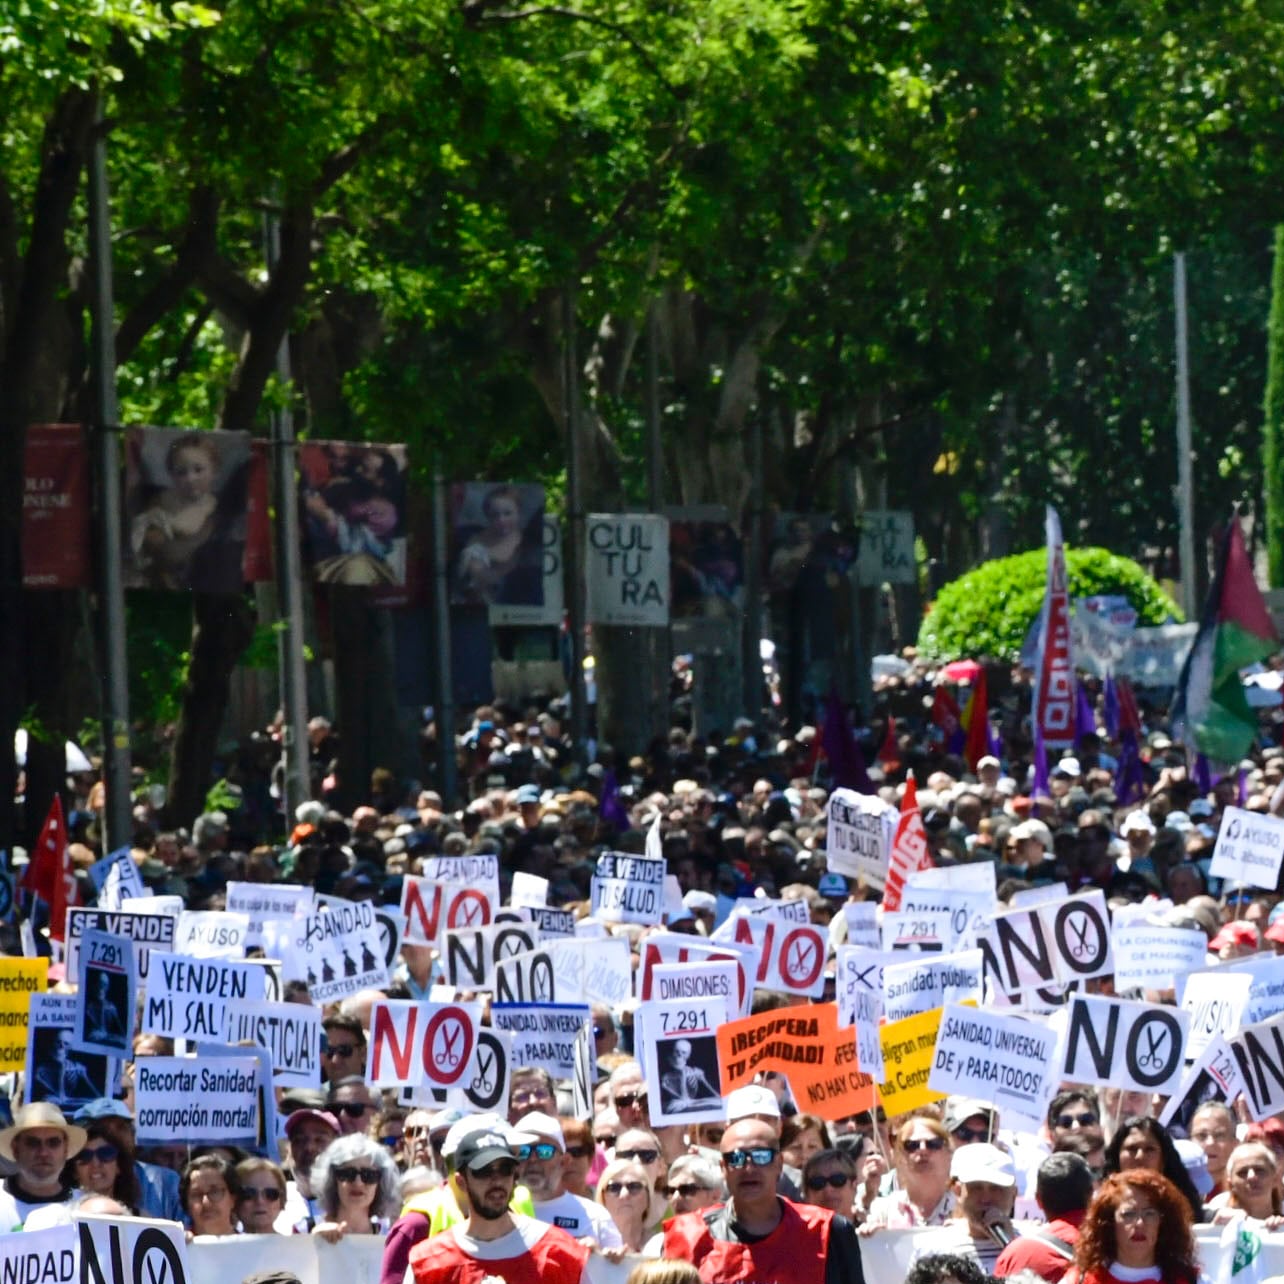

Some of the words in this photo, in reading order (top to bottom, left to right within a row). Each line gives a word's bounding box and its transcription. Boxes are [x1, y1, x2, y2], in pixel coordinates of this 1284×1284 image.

[588, 523, 653, 551] CUL
[600, 551, 643, 577] TU
[620, 579, 665, 607] RA
[835, 829, 849, 848] TU
[850, 832, 881, 860] SALUD
[615, 859, 663, 883] VENDE
[404, 880, 490, 942] NO
[613, 887, 657, 915] SALUD.
[105, 914, 175, 942] VENDE
[187, 926, 240, 945] AYUSO
[315, 905, 372, 941] SANIDAD
[532, 910, 575, 932] VENDE
[897, 921, 938, 938] 7.291
[91, 941, 122, 966] 7.291
[447, 927, 534, 986] NO
[734, 917, 826, 989] NO
[995, 900, 1108, 989] NO
[162, 959, 247, 999] VENDEN
[309, 978, 355, 999] RECORTES
[496, 951, 555, 1002] NO
[660, 976, 732, 999] DIMISIONES:
[888, 969, 939, 1000] Sanidad:
[496, 1014, 540, 1031] SANIDAD,
[660, 1010, 709, 1031] 7.291
[371, 1005, 474, 1085] NO
[941, 1016, 992, 1047] ¡SANIDAD,
[994, 1027, 1047, 1062] UNIVERSAL,
[1064, 999, 1183, 1087] NO
[726, 1063, 746, 1082] TU
[749, 1041, 824, 1068] SANIDAD!
[936, 1050, 954, 1072] DE
[955, 1060, 964, 1081] y
[139, 1067, 197, 1092] Recortar
[200, 1067, 257, 1097] Sanidad,
[807, 1084, 825, 1103] NO
[827, 1078, 849, 1097] HAY
[139, 1104, 208, 1133] corrupción
